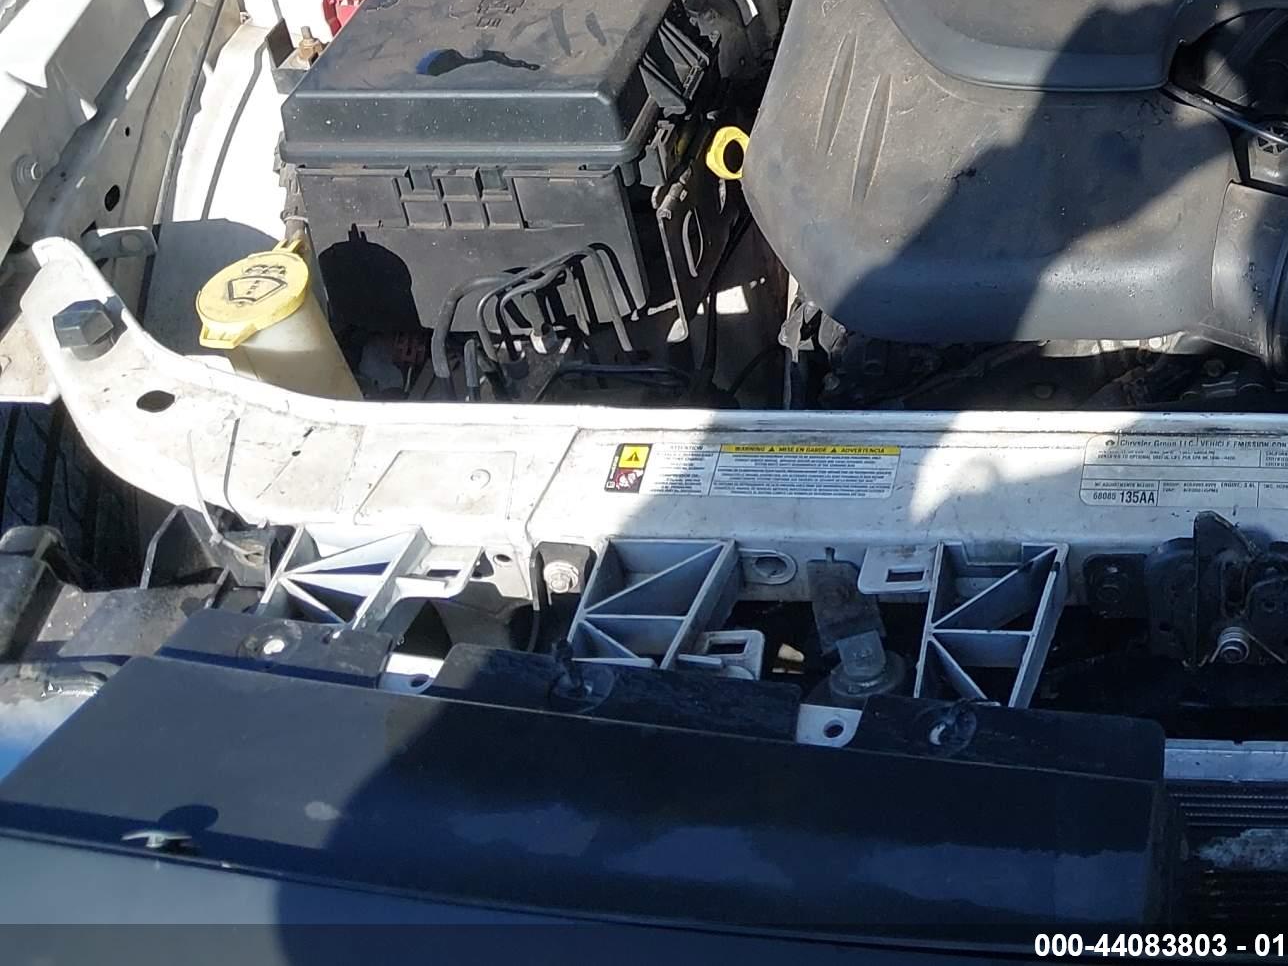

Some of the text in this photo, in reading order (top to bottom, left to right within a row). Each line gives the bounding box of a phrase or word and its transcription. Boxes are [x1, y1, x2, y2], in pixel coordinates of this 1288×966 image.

[1199, 439, 1231, 447] VEHICLE
[1233, 440, 1269, 448] EMISSION
[1119, 490, 1155, 504] 135AA
